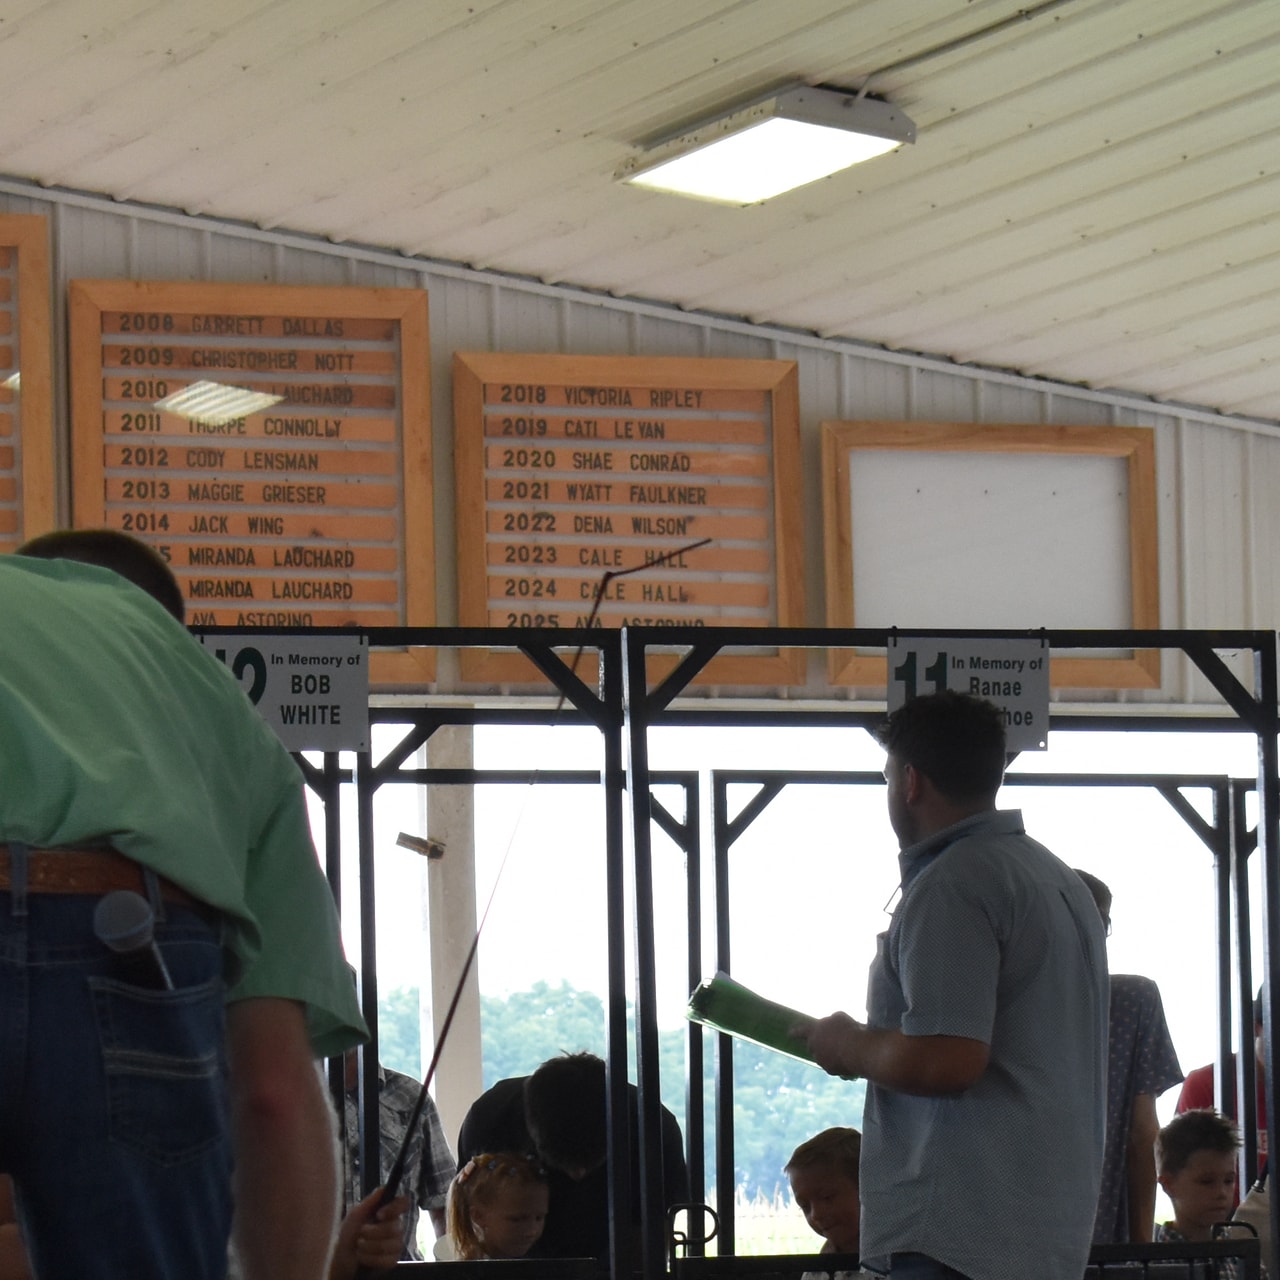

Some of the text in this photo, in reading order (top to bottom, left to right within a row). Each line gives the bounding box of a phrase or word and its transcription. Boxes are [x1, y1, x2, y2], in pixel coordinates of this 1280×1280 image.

[119, 315, 343, 336] 2008 GARRETT DALLAS
[120, 348, 354, 371] 2009 CHRISTOPHER NOTT
[122, 381, 168, 398] 2010
[502, 387, 702, 408] 2018 VICTORIA RIPLEY
[121, 414, 341, 436] 2011 THORPE CONNOLLY
[502, 419, 598, 437] 2019 CATI
[121, 449, 318, 470] 2012 CODY LENSMAN
[504, 450, 690, 471] 2020 SHAE CONRAD
[123, 482, 326, 504] 2013 MAGGIE GRIESER
[504, 482, 706, 504] 2021 WYATT FAULKNER
[122, 514, 283, 535] 2014 JACK WING
[504, 513, 686, 535] 2022 DENA WILSON
[189, 548, 354, 568] MIRANDA LAUCHARD
[505, 546, 688, 568] 2023 CALE HALL
[189, 580, 352, 600] MIRANDA LAUCHARD
[505, 579, 688, 602] 2024 CALE HALL
[271, 654, 360, 667] In Memory of
[953, 657, 1042, 672] In Memory of
[292, 675, 331, 694] BOB
[970, 677, 1021, 696] Ranae
[281, 705, 341, 724] WHITE
